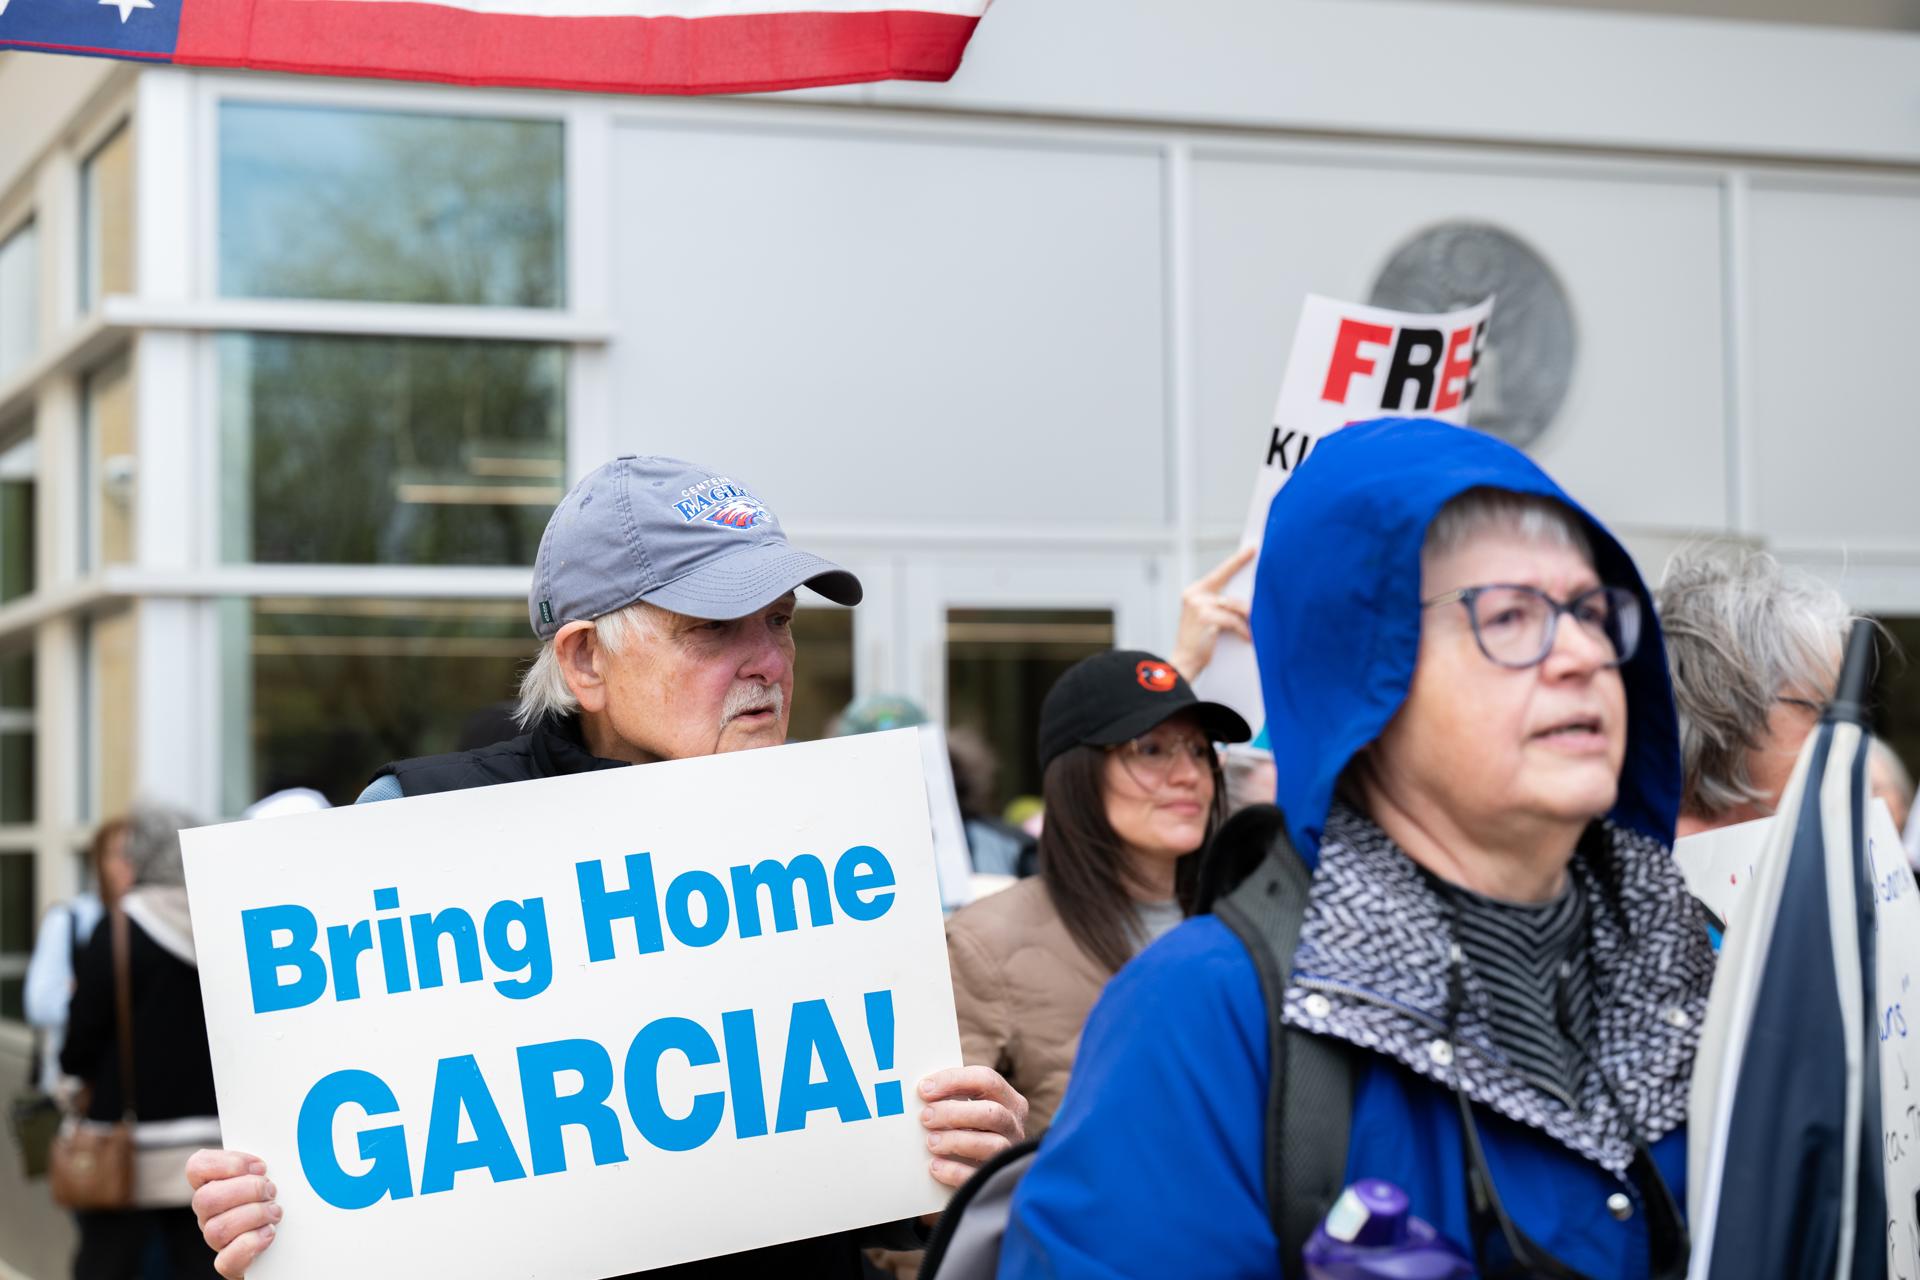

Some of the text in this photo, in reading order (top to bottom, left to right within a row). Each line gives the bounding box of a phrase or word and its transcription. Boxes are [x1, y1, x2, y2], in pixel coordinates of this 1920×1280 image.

[1266, 426, 1309, 472] KI
[241, 845, 896, 1014] Bring Home
[296, 989, 905, 1210] GARCIA!
